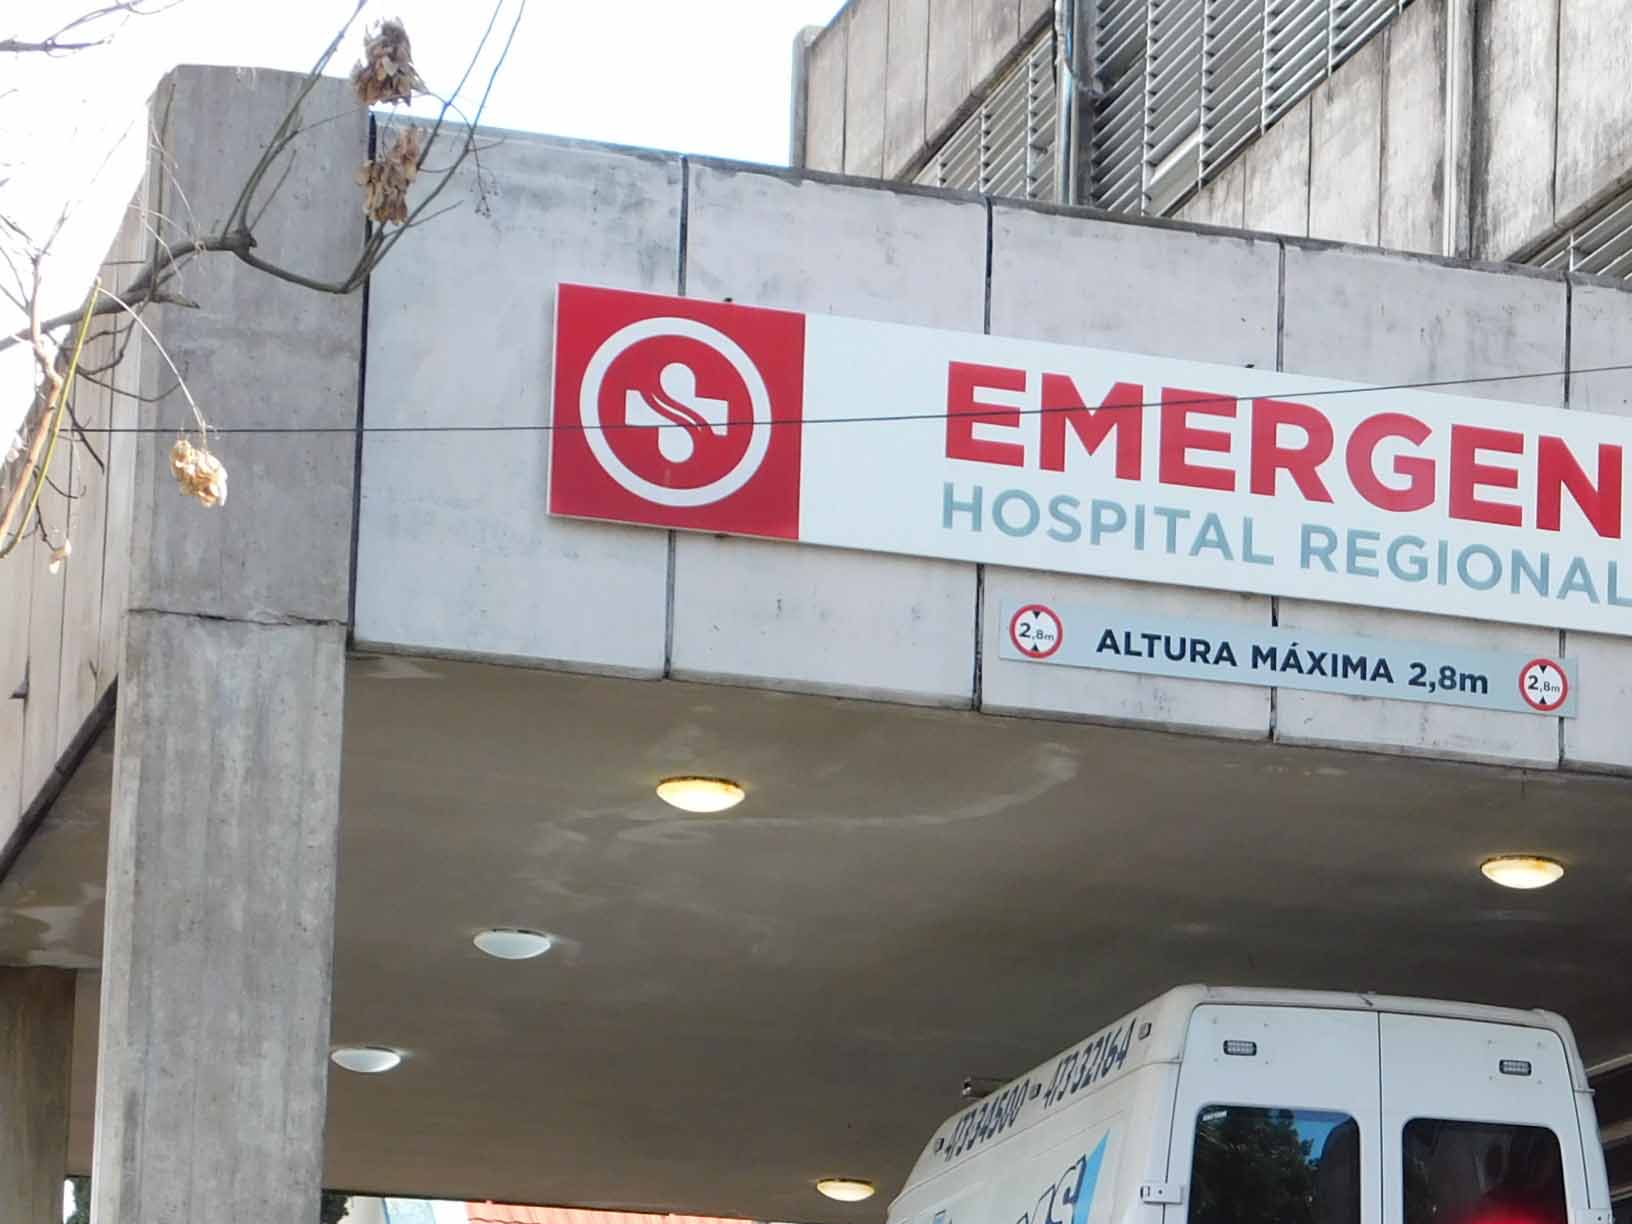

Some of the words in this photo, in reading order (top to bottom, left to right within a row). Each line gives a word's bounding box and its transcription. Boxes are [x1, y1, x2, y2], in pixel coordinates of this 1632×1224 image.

[942, 481, 1274, 565] HOSPITAL
[1096, 629, 1237, 667] ALTURA
[1251, 642, 1394, 684] MÁXIMA
[1408, 662, 1488, 694] 2,8m
